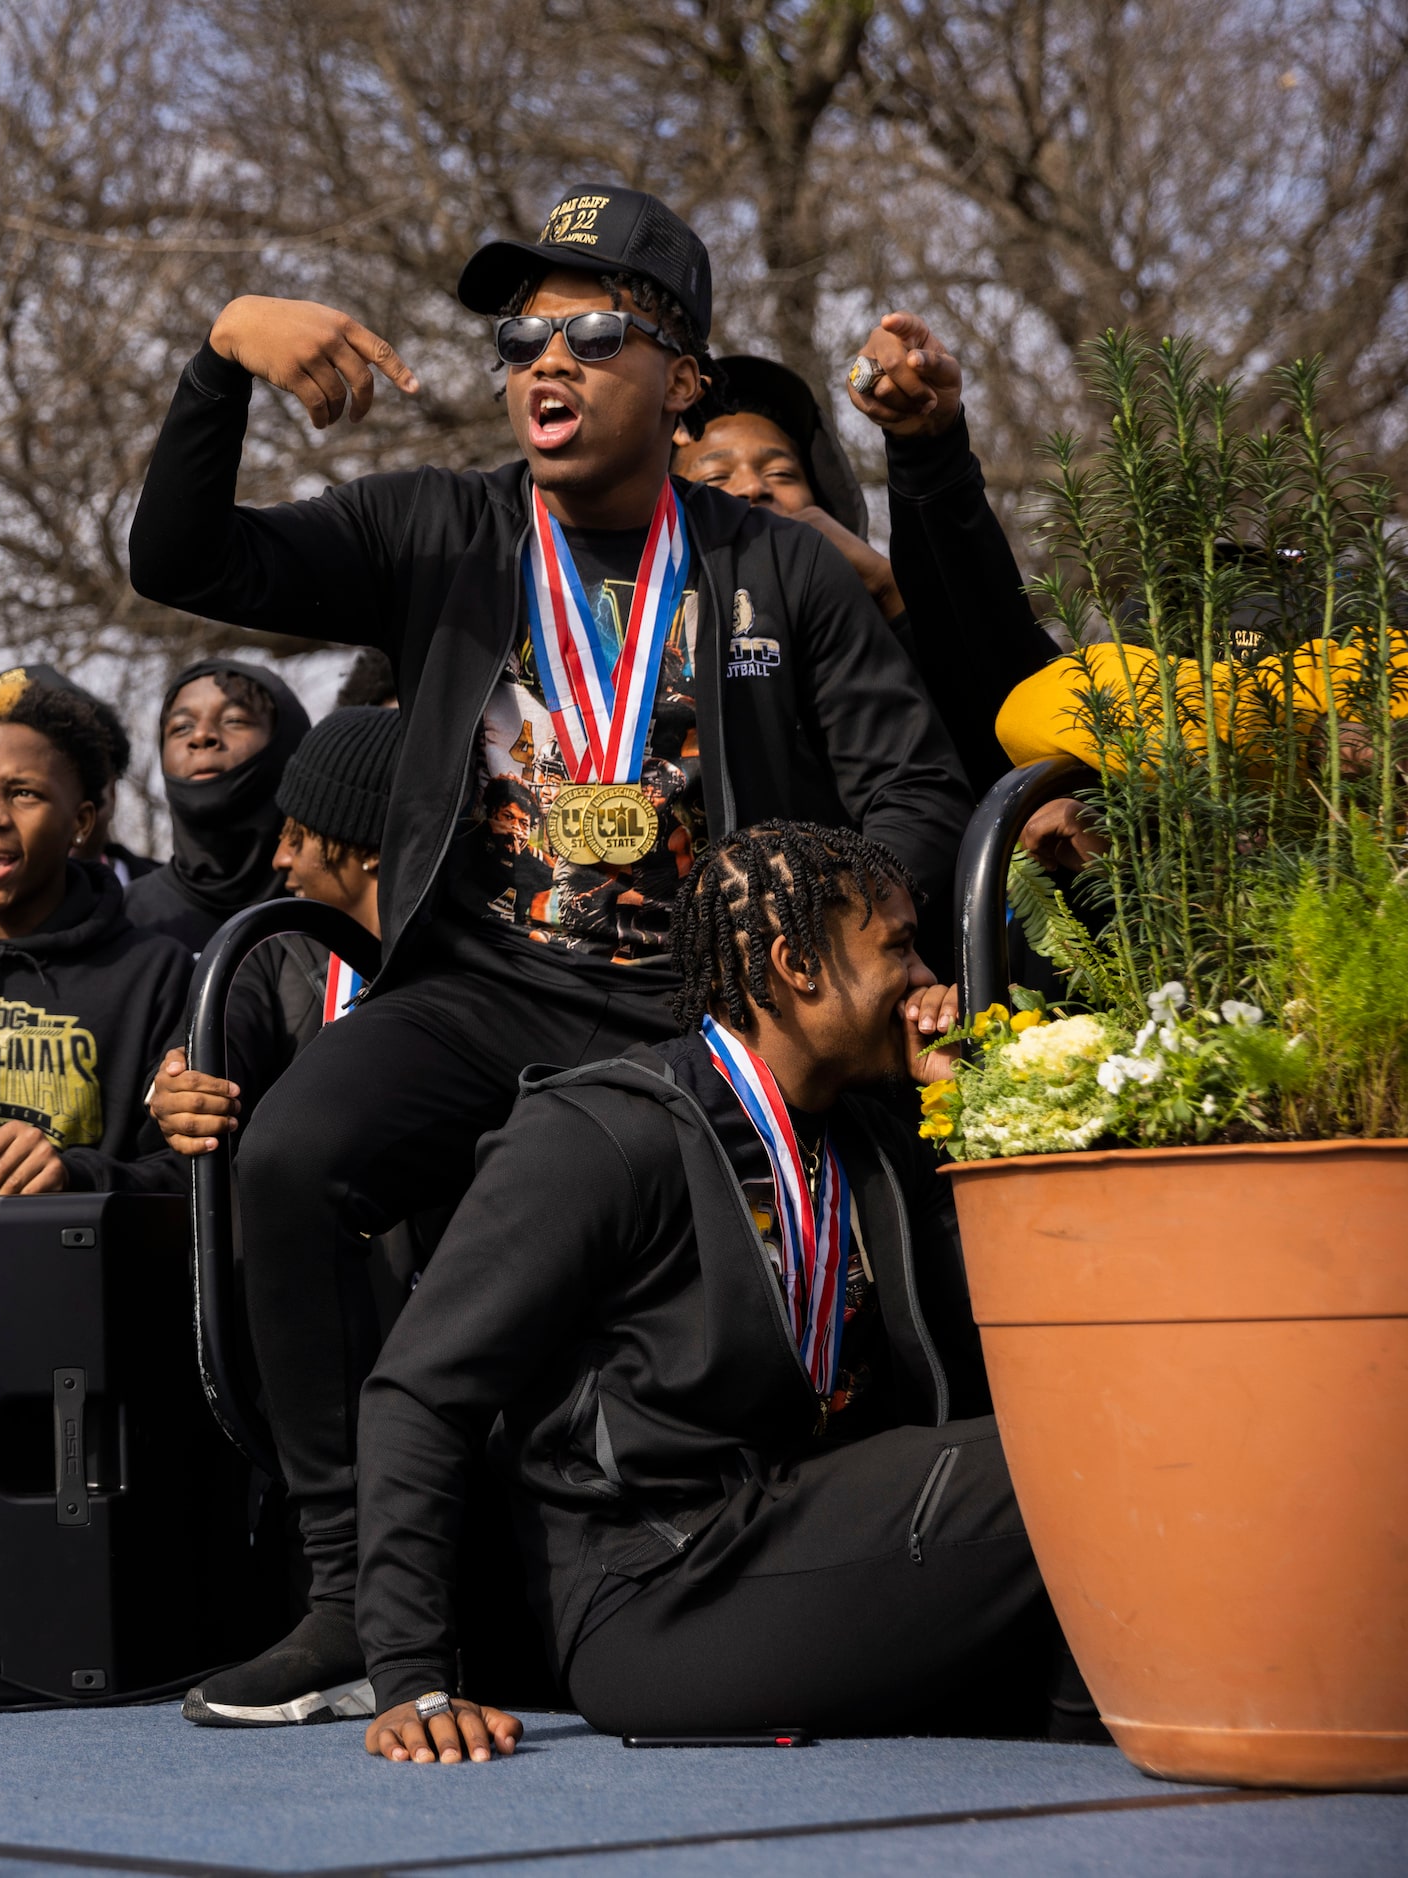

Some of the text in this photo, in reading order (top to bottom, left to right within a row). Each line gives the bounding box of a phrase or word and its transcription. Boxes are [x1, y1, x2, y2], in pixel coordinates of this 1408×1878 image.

[577, 195, 610, 209] CLIFF
[570, 208, 598, 231] 22
[729, 637, 781, 667] OC
[606, 838, 637, 848] STATE
[65, 1418, 79, 1475] QSC
